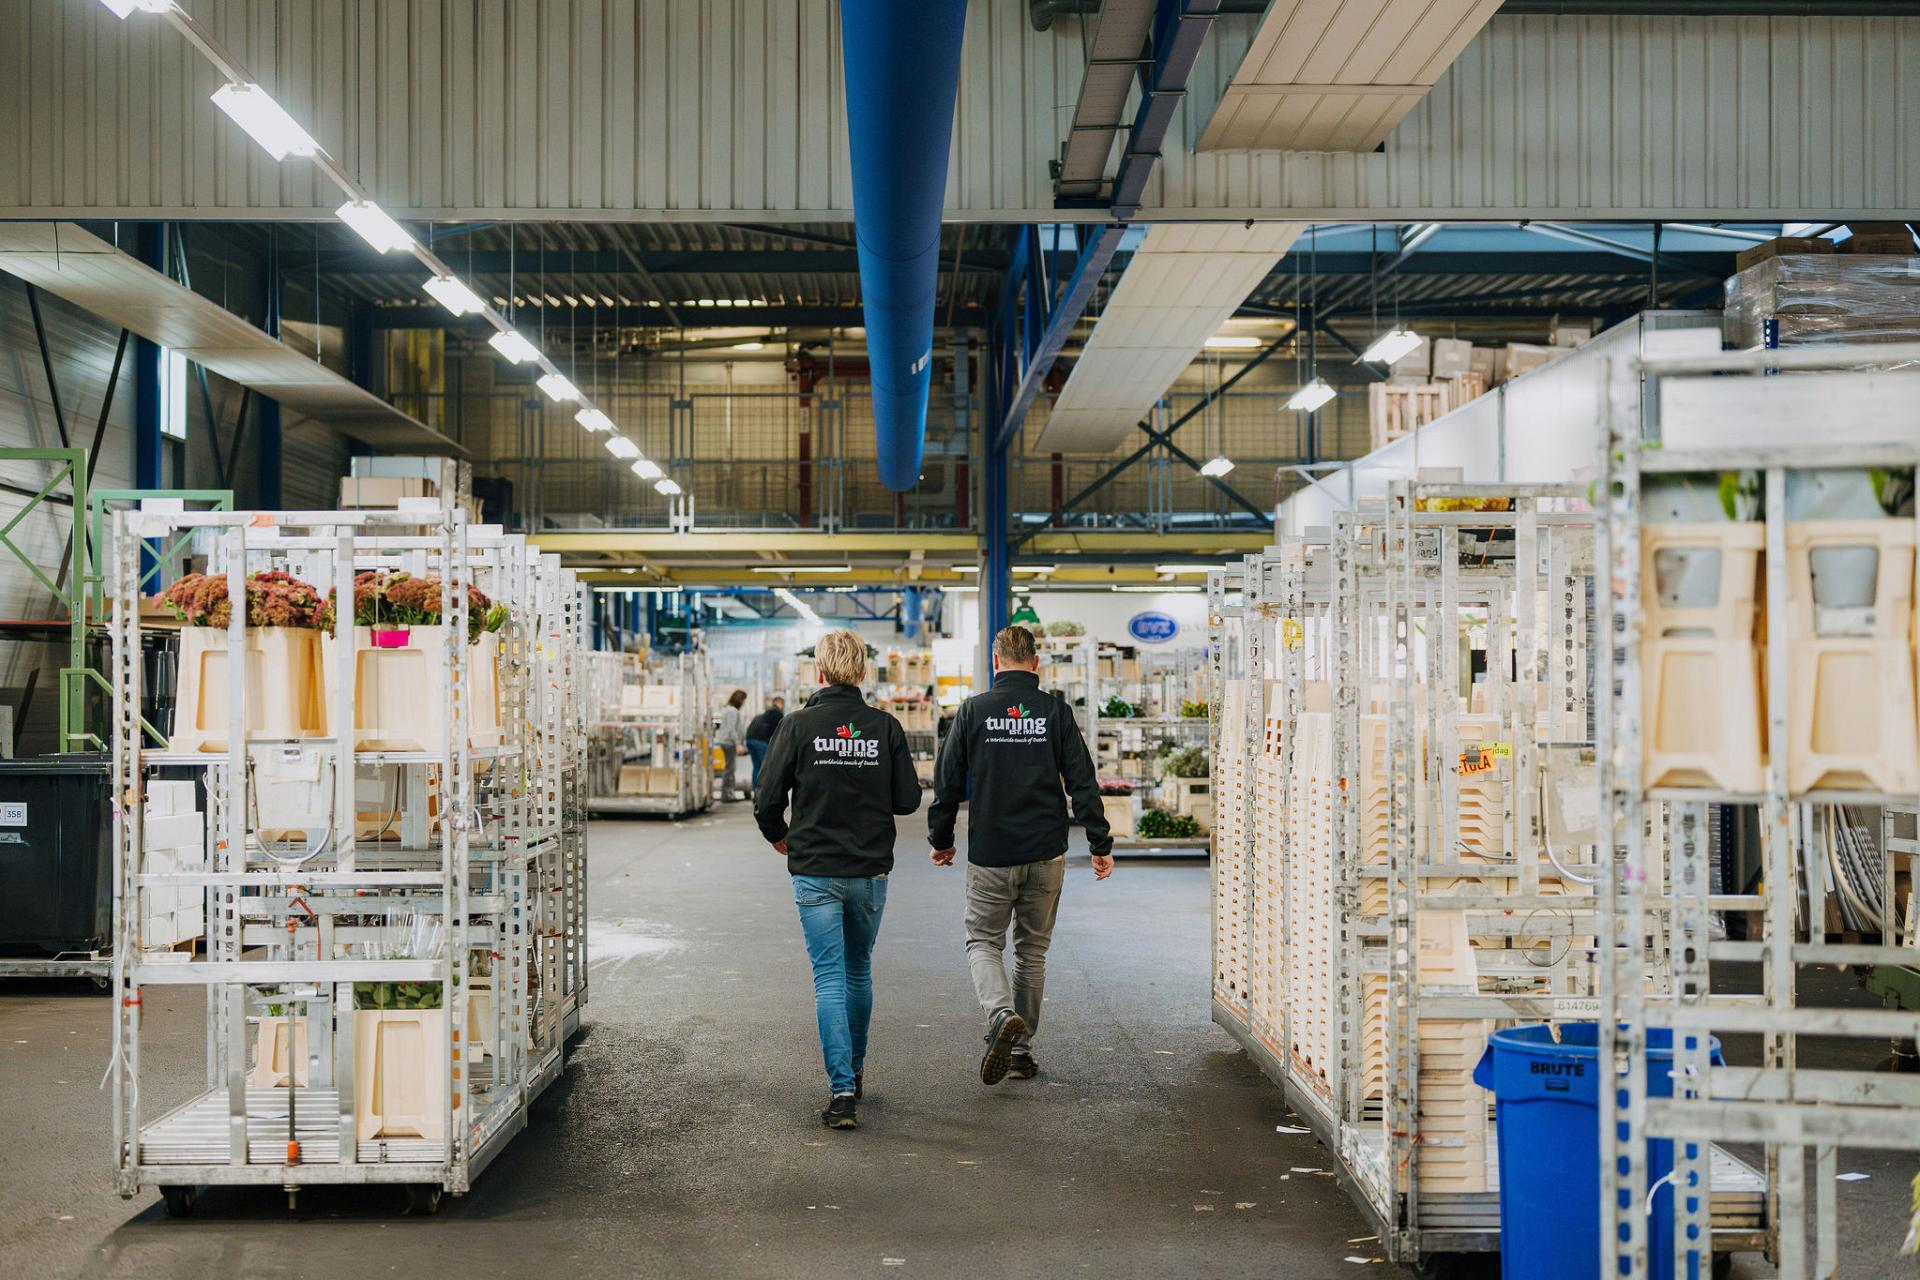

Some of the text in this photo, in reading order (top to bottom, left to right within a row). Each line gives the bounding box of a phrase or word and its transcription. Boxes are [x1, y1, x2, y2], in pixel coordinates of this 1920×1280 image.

[985, 716, 1047, 735] tuning
[813, 736, 879, 758] tuning
[6, 810, 22, 818] 358
[1530, 1060, 1585, 1077] BRUTE
